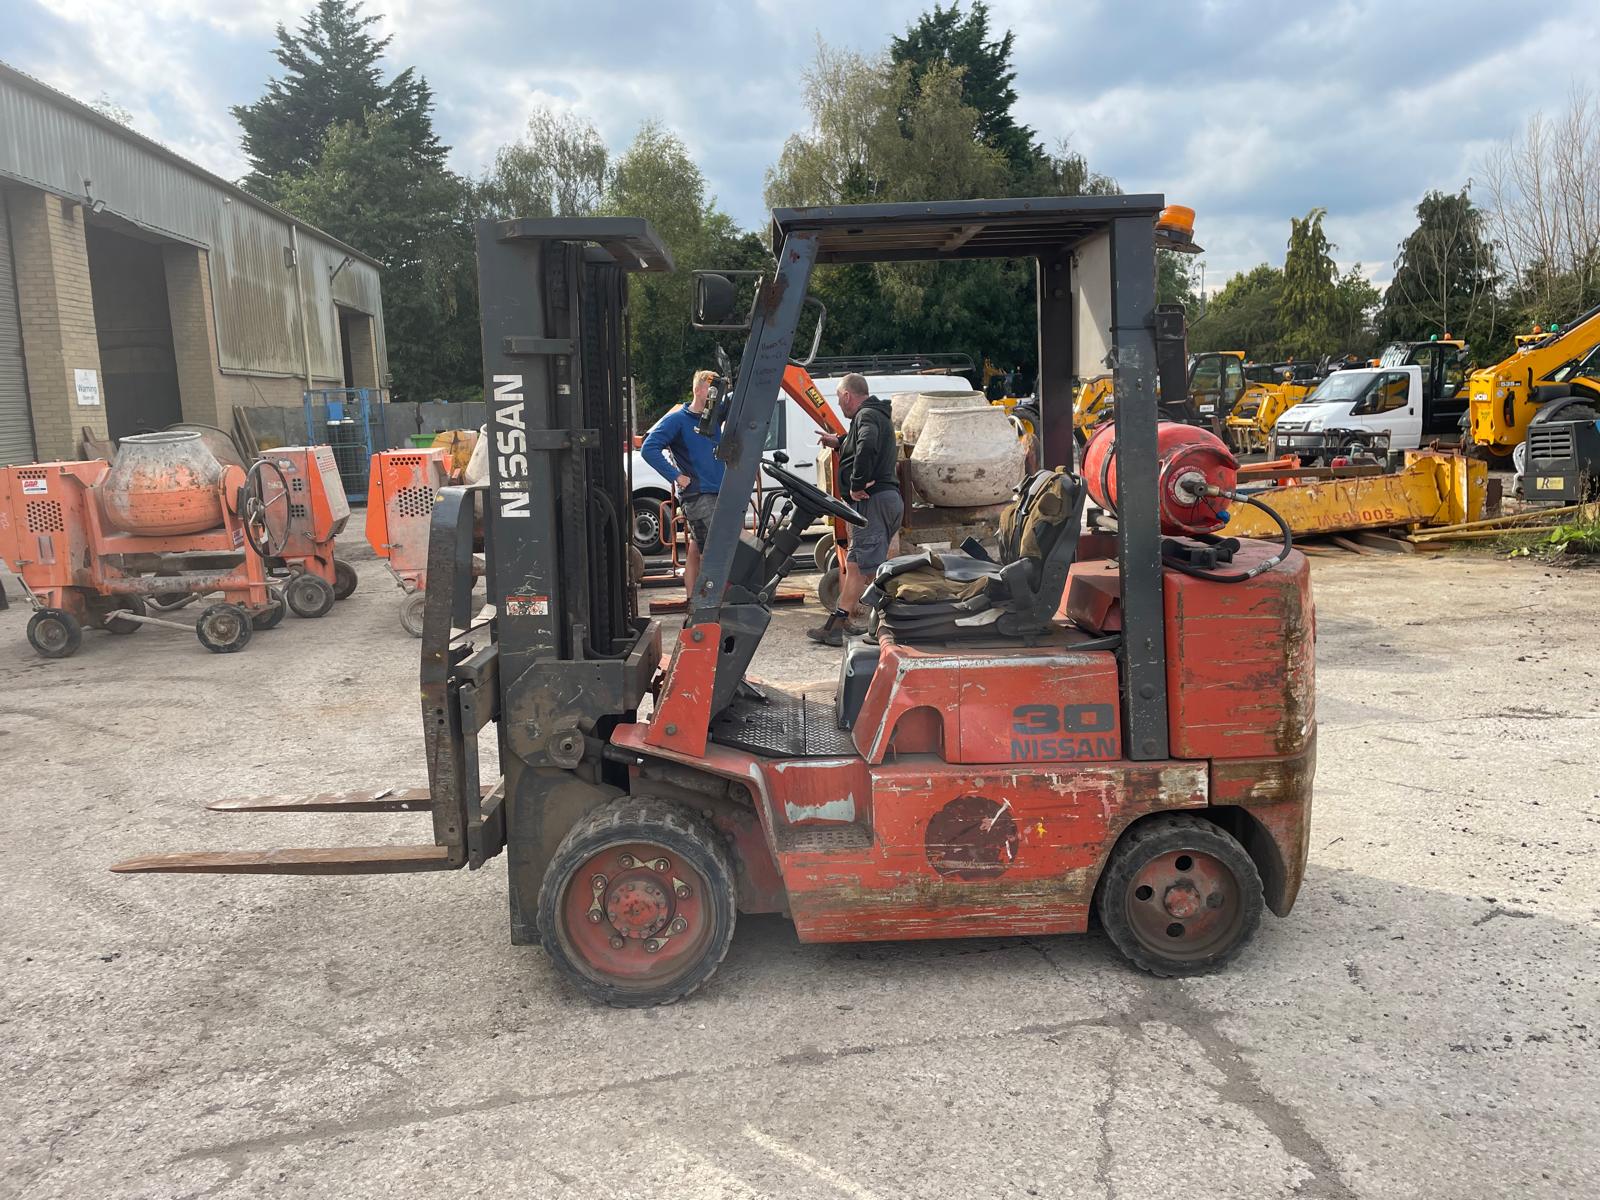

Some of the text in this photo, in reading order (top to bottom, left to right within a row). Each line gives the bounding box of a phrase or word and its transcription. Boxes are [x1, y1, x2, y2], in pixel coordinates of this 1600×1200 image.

[77, 384, 97, 394] Warning
[1474, 393, 1488, 401] JCB
[493, 375, 530, 518] NISSAN
[1013, 704, 1114, 734] 30
[1011, 737, 1116, 760] NISSAN
